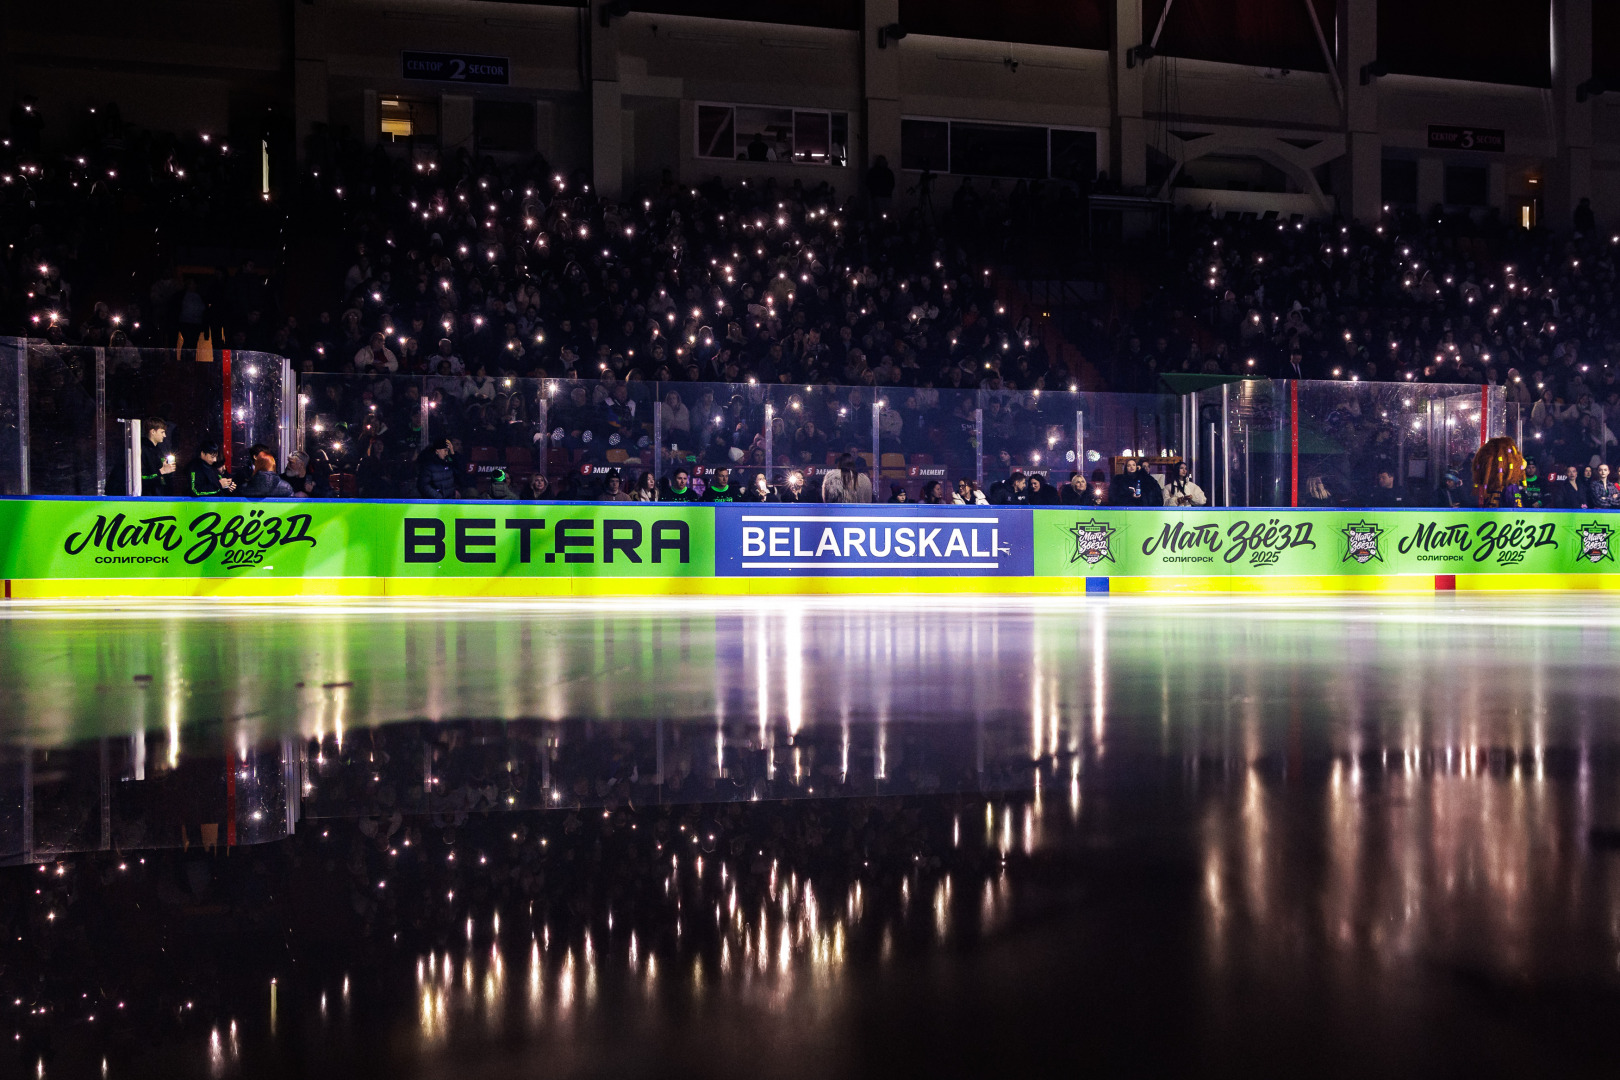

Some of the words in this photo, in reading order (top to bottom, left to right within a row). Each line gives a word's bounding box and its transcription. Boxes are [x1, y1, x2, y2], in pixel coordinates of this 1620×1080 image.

[407, 60, 443, 72] СЕКТОР
[449, 59, 467, 80] 2
[469, 64, 504, 76] SECTOR
[1460, 130, 1475, 149] 3
[583, 465, 590, 474] 5
[696, 466, 702, 475] 5
[911, 467, 917, 476] 5
[64, 513, 182, 555] Матч
[742, 527, 998, 558] BELARUSKALI
[1142, 521, 1223, 556] Матч
[1398, 521, 1473, 555] Матч
[94, 556, 169, 564] СОЛИГОРСК
[221, 549, 267, 566] 2025
[1249, 551, 1282, 563] 2025
[1496, 550, 1527, 562] 2025
